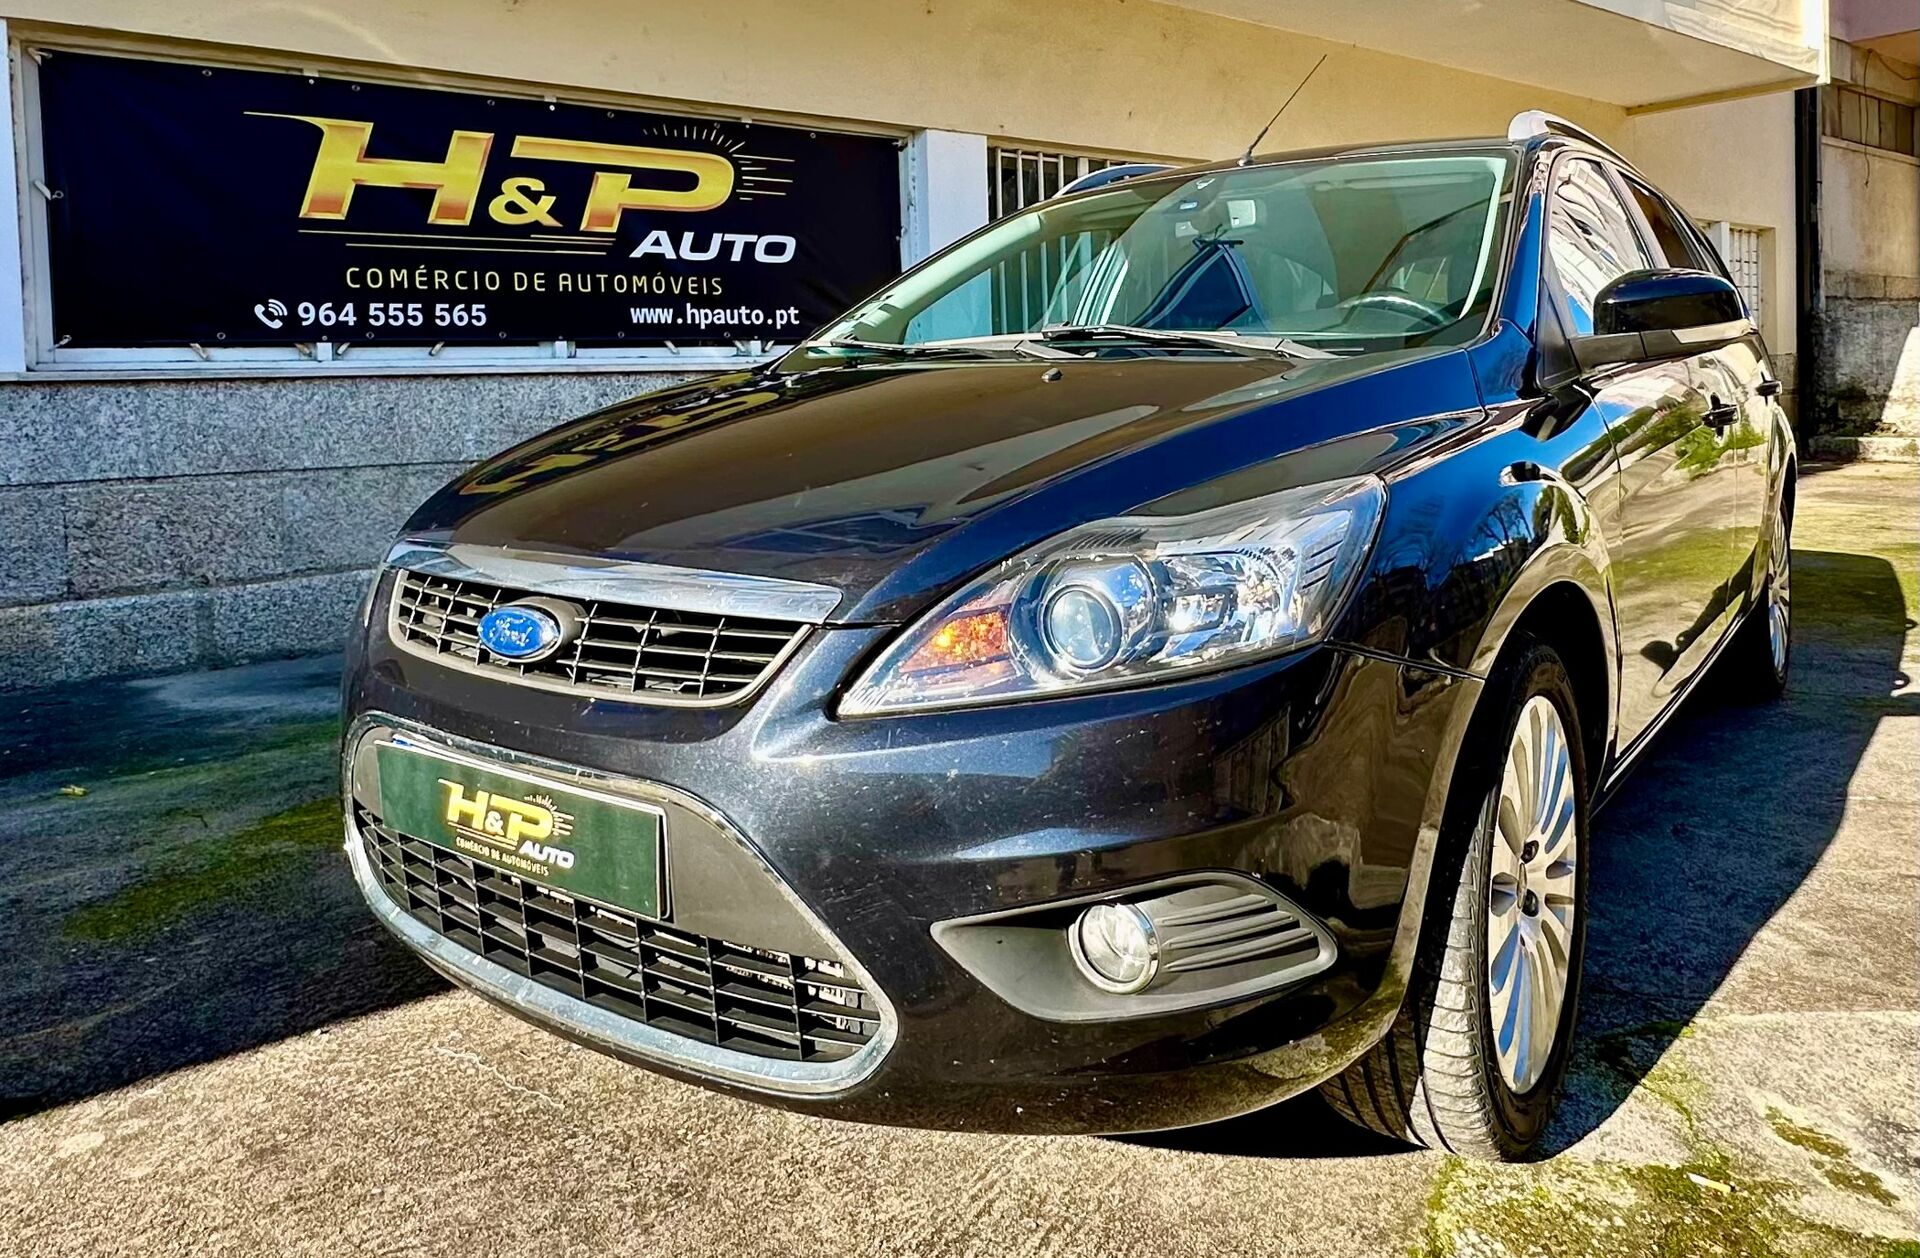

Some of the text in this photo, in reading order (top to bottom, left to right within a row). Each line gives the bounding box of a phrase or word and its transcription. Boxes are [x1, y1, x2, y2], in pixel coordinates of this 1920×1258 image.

[244, 111, 735, 233] H&P
[628, 230, 797, 264] AUTO
[345, 264, 723, 296] COMÉRCIO DE AUTOMÓVEIS
[297, 301, 488, 328] 964 555 565
[630, 302, 801, 330] www.hpauto.pt
[437, 778, 554, 843] H&P
[518, 839, 575, 869] AUTO
